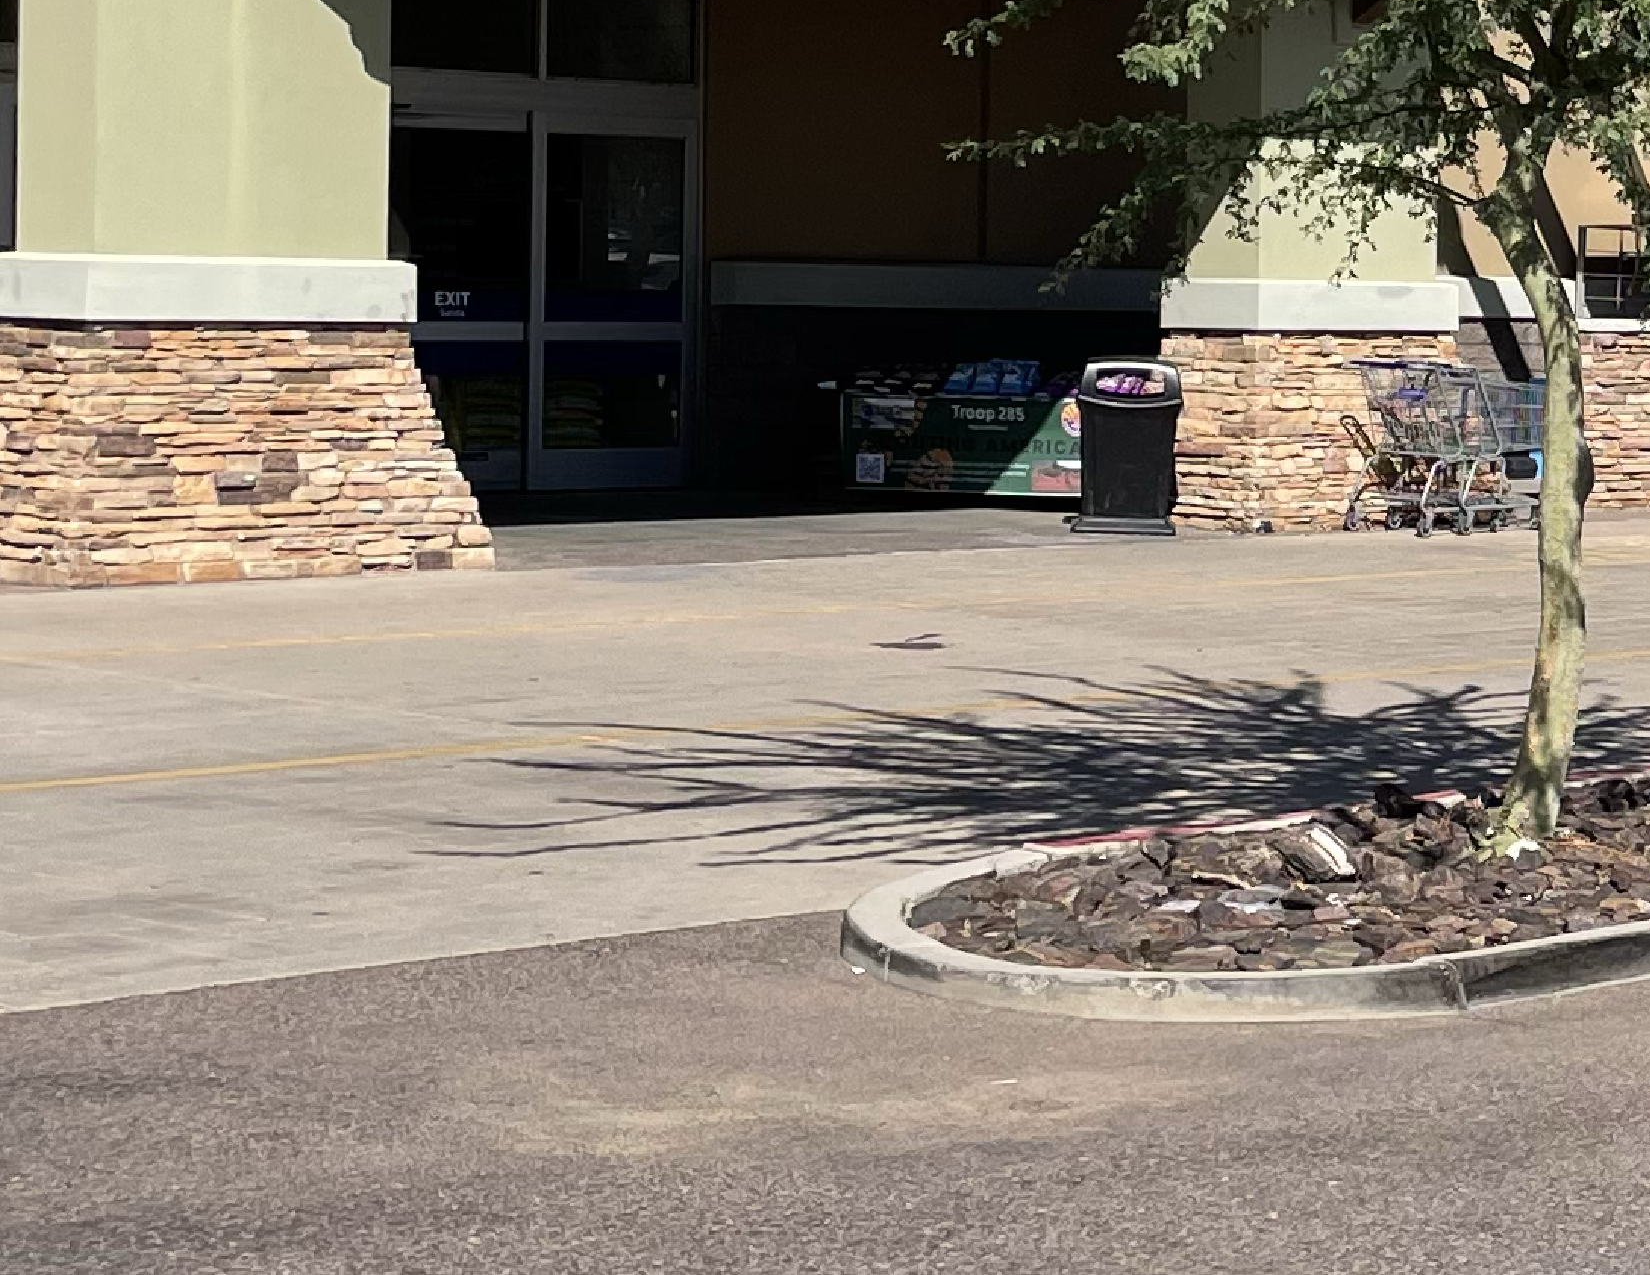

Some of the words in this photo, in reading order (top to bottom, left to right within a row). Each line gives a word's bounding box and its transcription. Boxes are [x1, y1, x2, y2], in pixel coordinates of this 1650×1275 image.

[434, 291, 471, 306] EXIT
[951, 404, 996, 423] Troop
[999, 406, 1026, 422] 285
